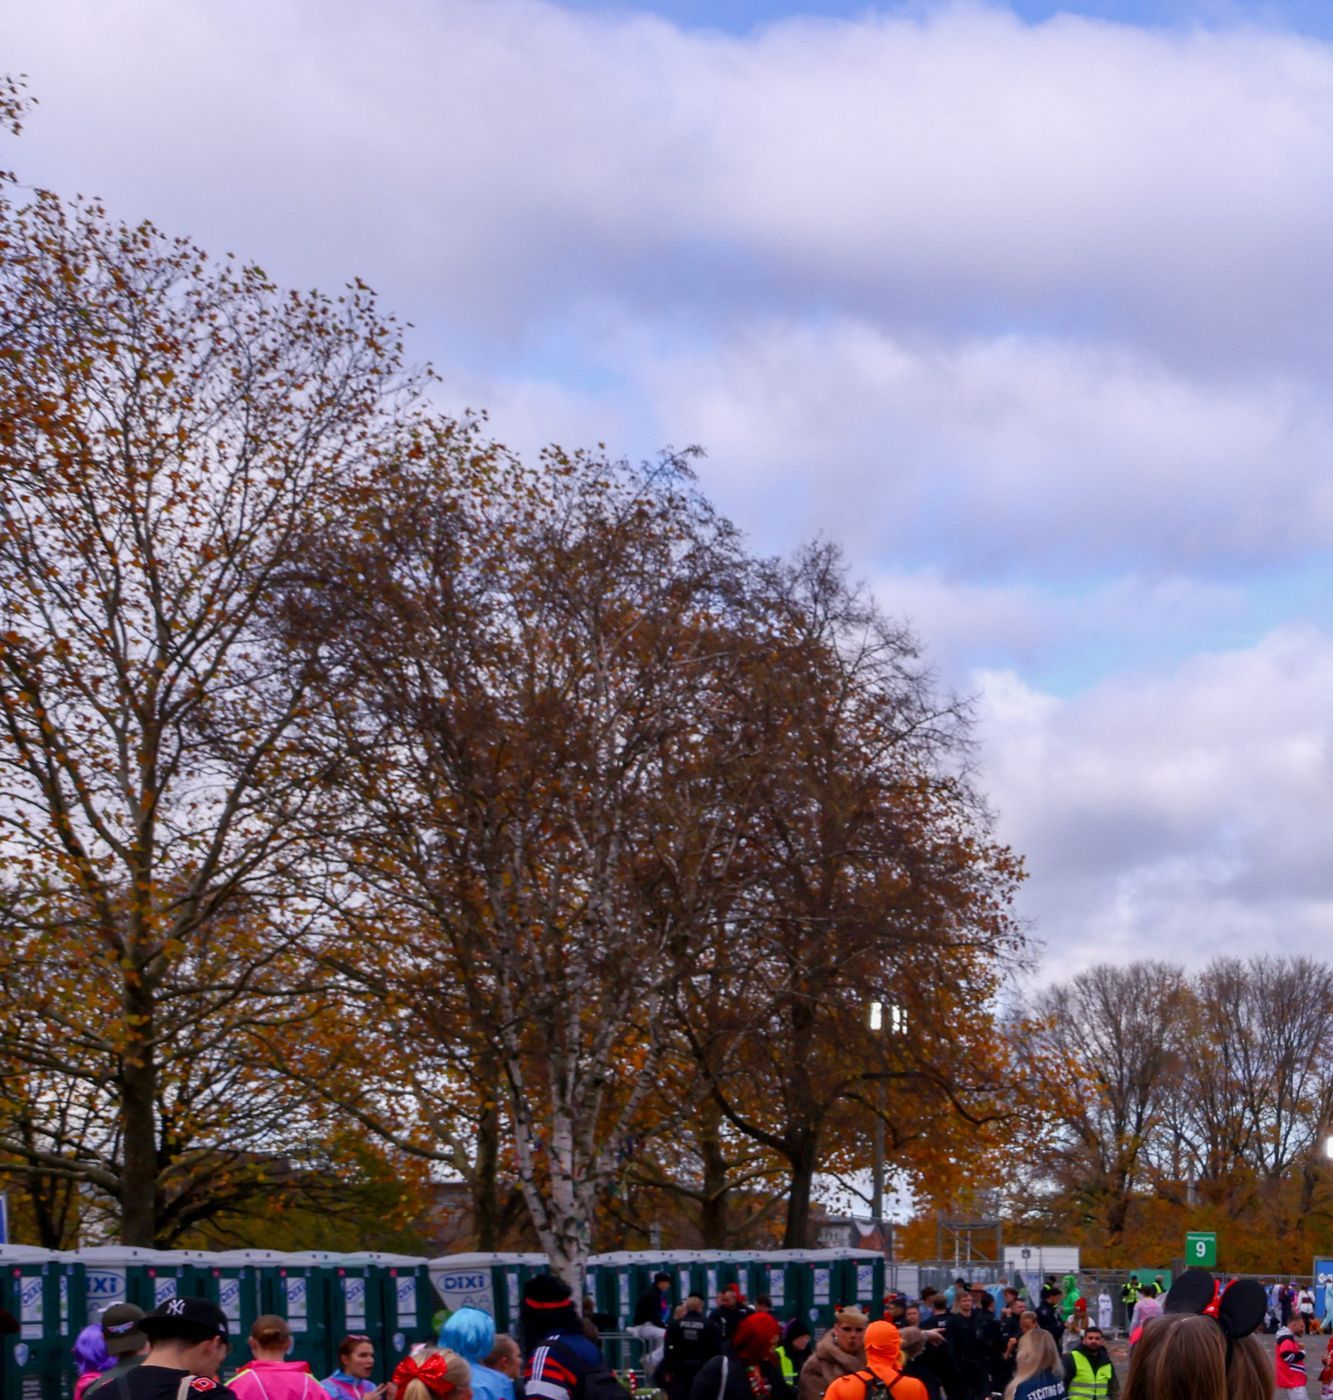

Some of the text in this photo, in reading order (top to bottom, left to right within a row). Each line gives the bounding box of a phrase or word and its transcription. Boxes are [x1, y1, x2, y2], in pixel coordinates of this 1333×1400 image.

[1196, 1241, 1206, 1257] 9
[86, 1276, 118, 1294] iXi
[166, 1299, 186, 1316] NY
